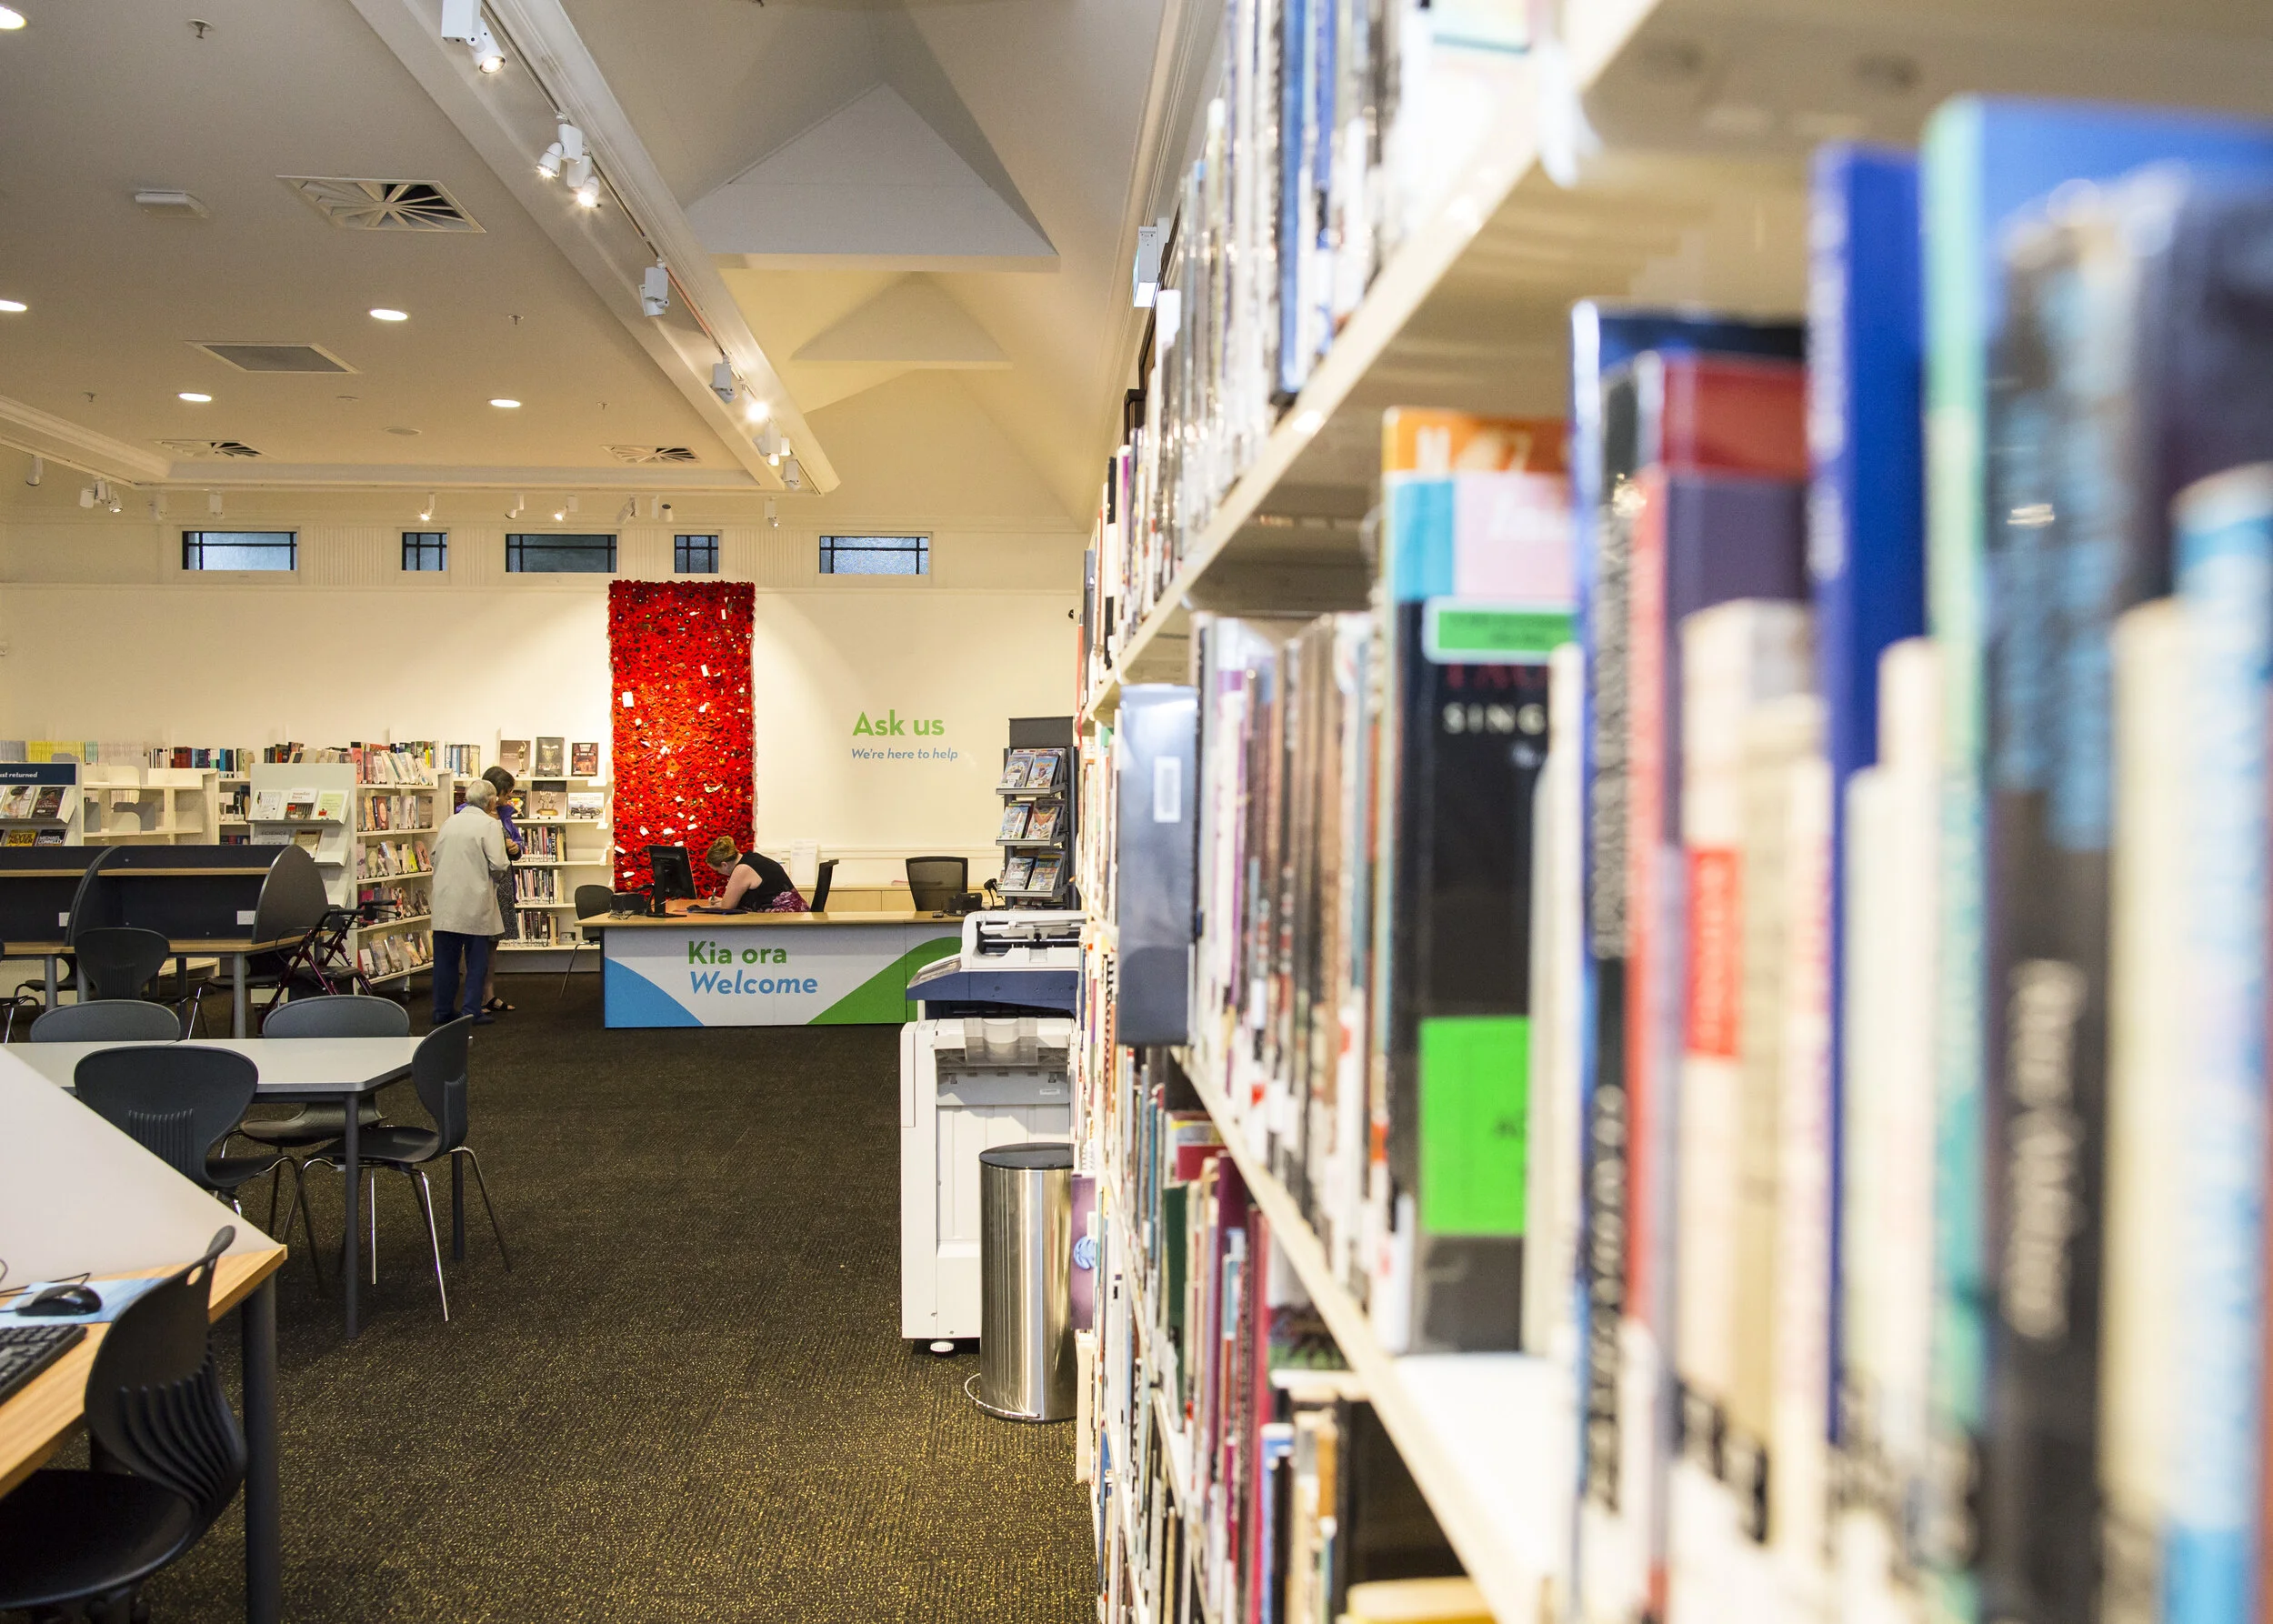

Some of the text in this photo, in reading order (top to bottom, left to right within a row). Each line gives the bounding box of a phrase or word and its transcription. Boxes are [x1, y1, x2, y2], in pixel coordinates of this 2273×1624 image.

[852, 709, 945, 736] Ask us
[852, 747, 958, 762] We're here to help
[688, 940, 786, 964] Kia ora
[690, 969, 817, 994] Welcome
